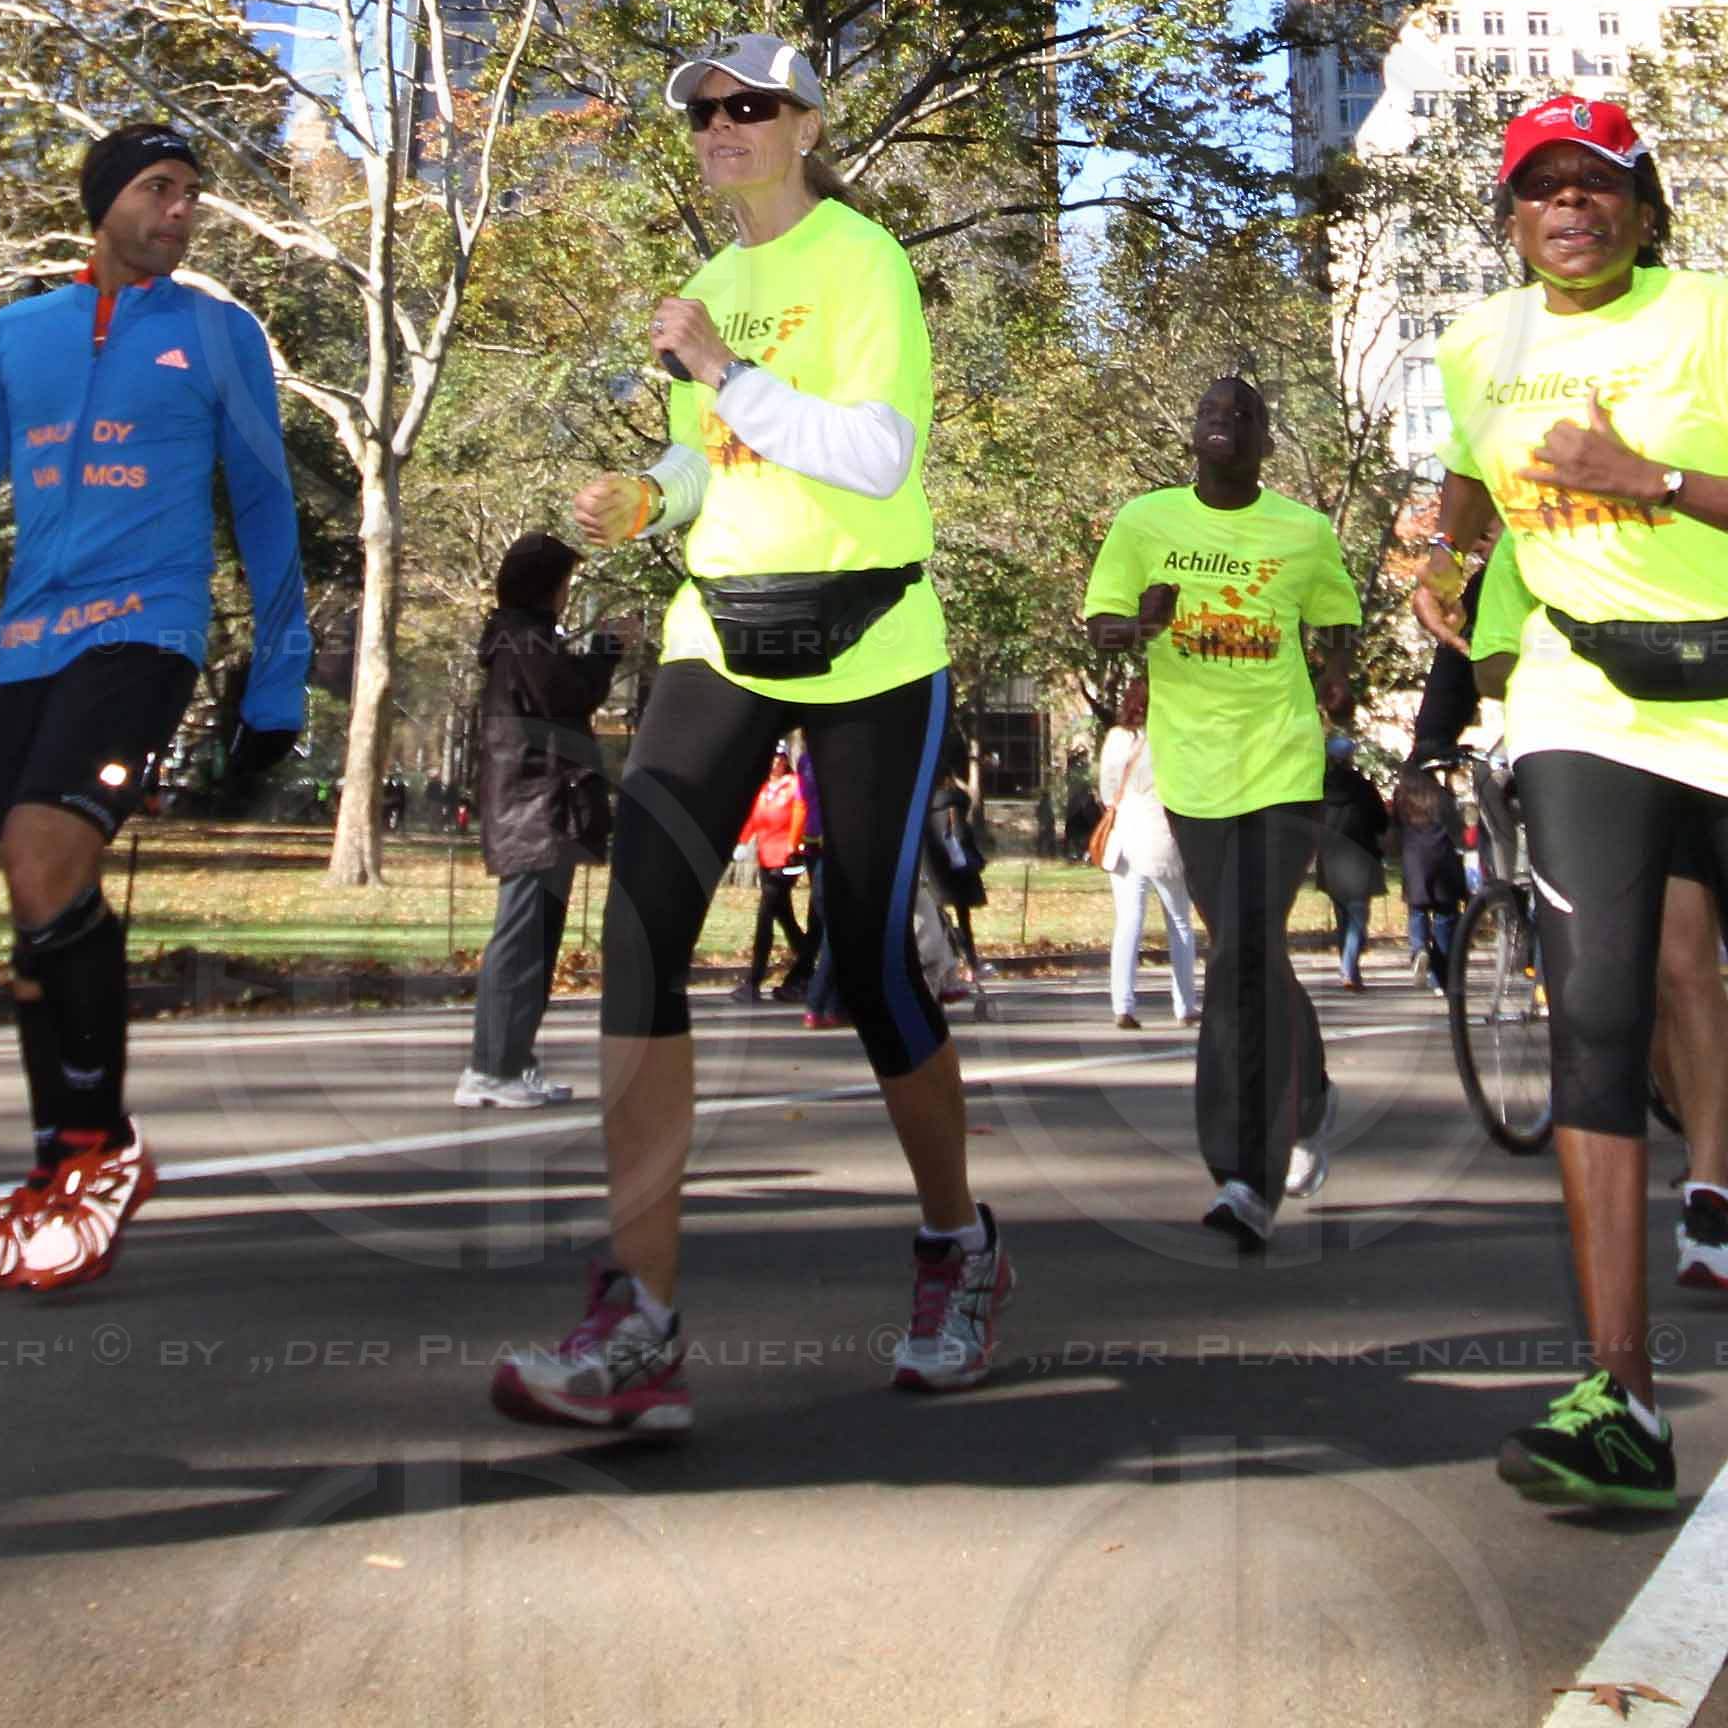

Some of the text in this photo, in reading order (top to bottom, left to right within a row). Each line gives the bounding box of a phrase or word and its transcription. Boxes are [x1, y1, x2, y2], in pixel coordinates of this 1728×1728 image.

[720, 312, 774, 342] illes
[1485, 372, 1599, 405] Achilles
[1163, 550, 1252, 577] Achilles
